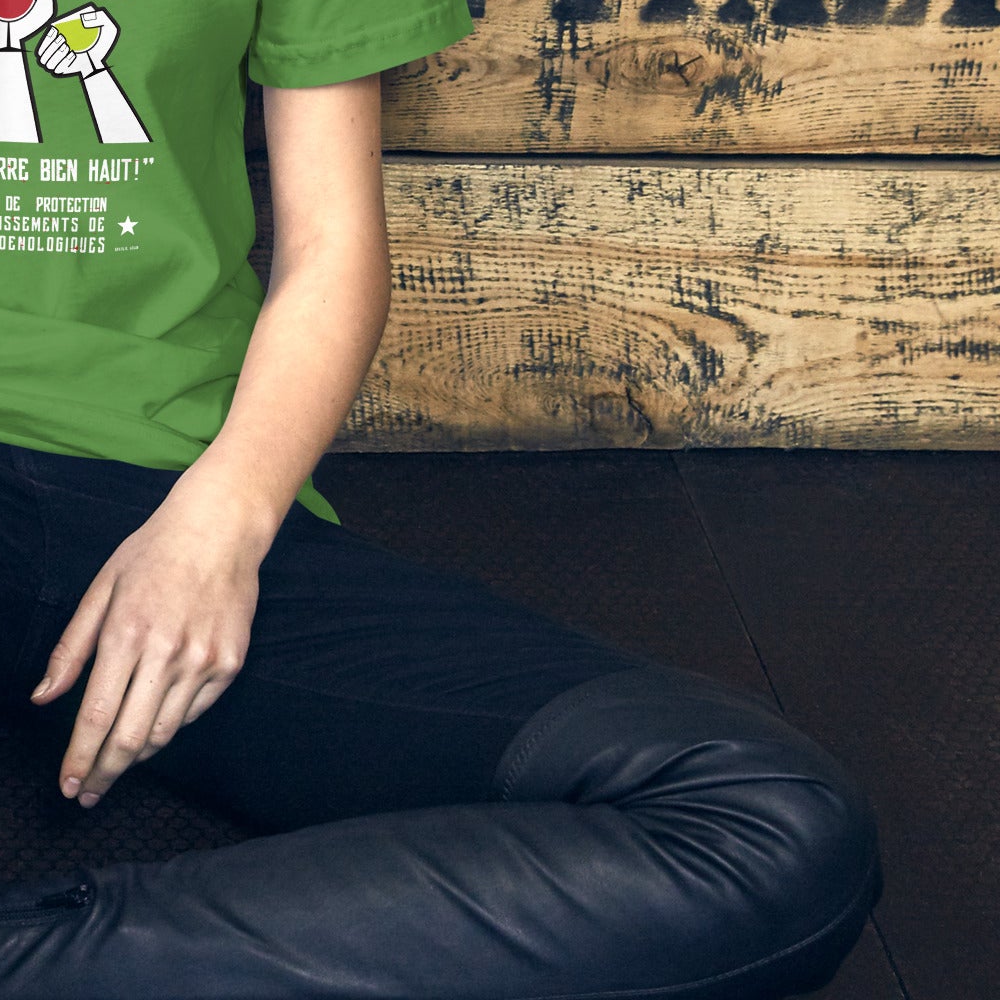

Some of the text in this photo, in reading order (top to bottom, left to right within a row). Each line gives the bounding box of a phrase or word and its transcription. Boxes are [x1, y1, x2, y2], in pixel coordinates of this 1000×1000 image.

[40, 158, 78, 182] BIEN
[5, 195, 20, 211] DE
[36, 197, 107, 213] PROTECTION
[89, 217, 104, 232] DE
